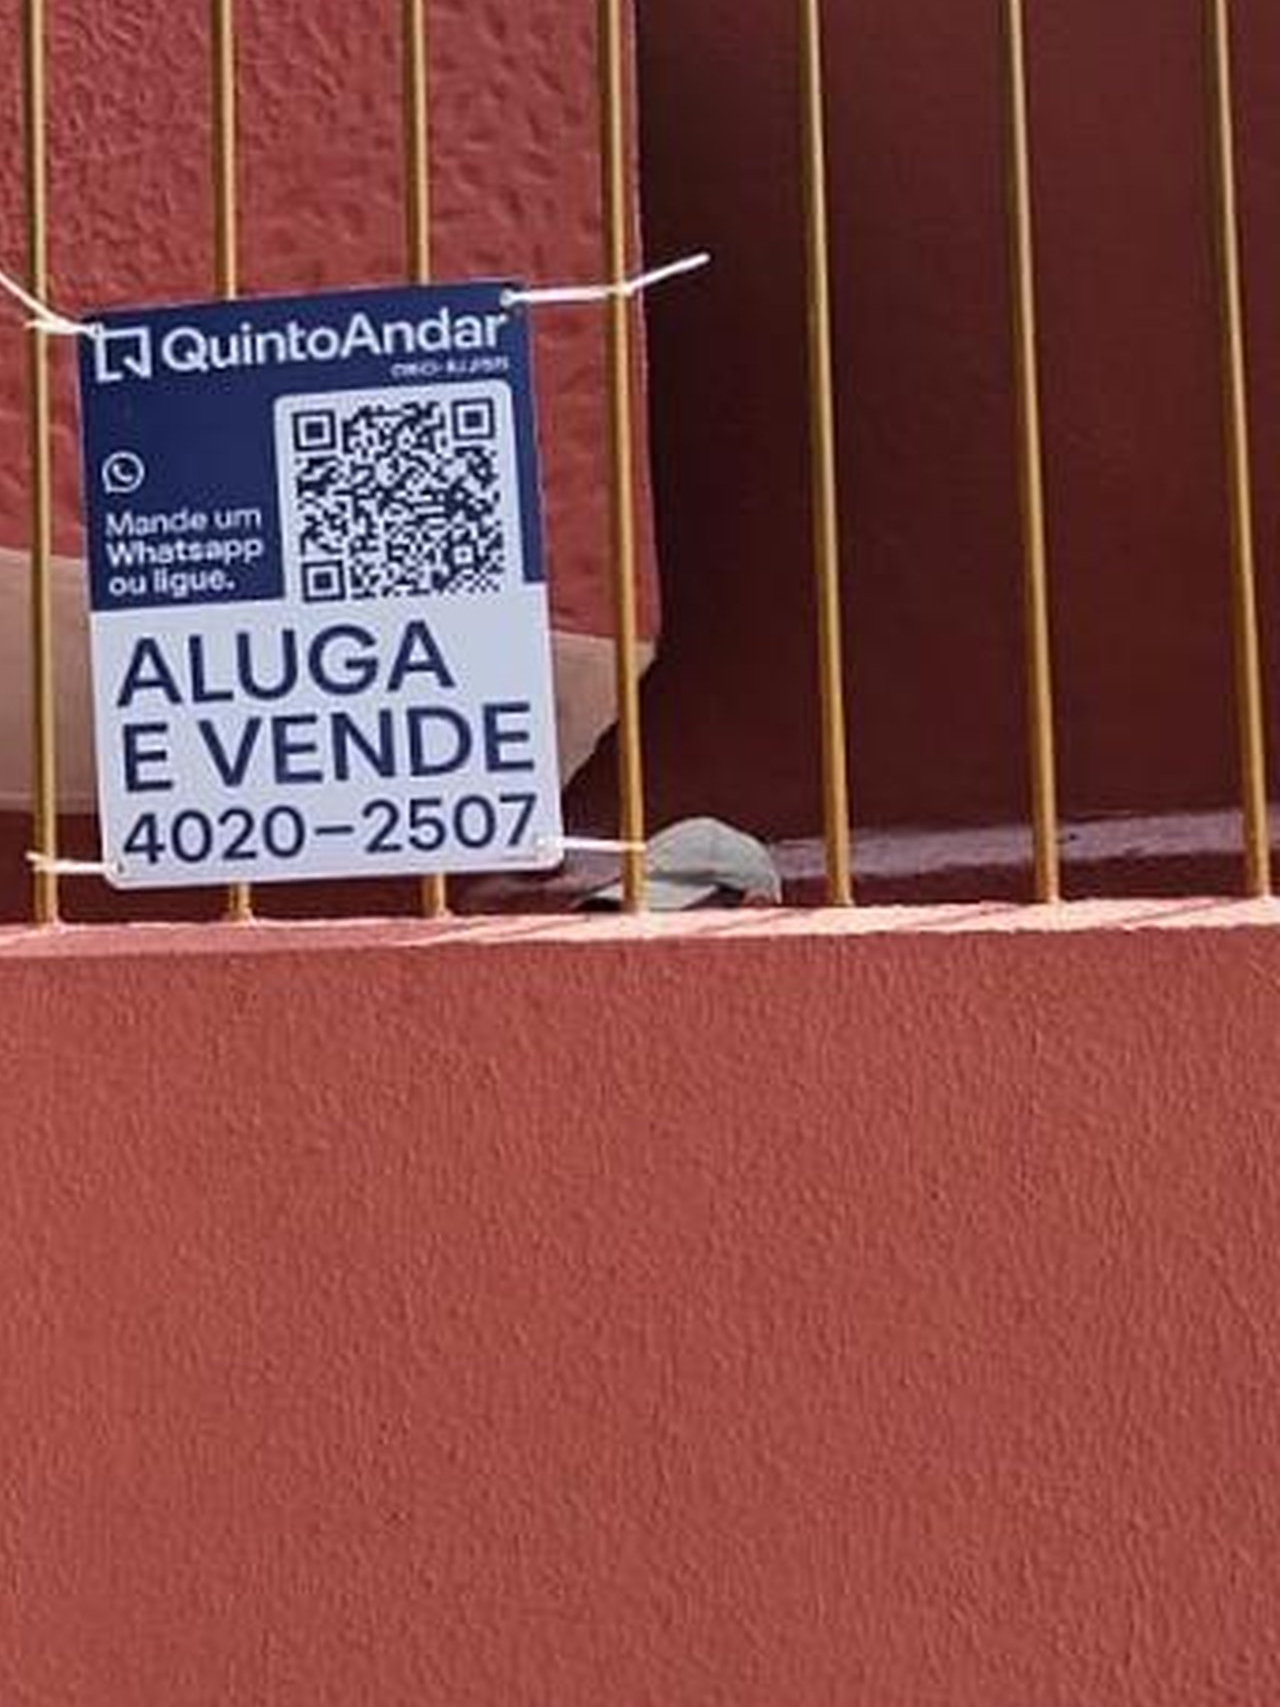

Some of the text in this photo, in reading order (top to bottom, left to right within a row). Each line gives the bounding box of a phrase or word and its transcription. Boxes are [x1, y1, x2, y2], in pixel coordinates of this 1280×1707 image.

[161, 307, 508, 372] QuintoAndar
[105, 509, 263, 537] Mande um
[106, 538, 265, 566] Whatsapp
[108, 567, 236, 599] ou ligue.
[116, 620, 456, 708] ALUGA
[122, 702, 536, 793] E VENDE
[123, 792, 538, 865] 4020-2507
